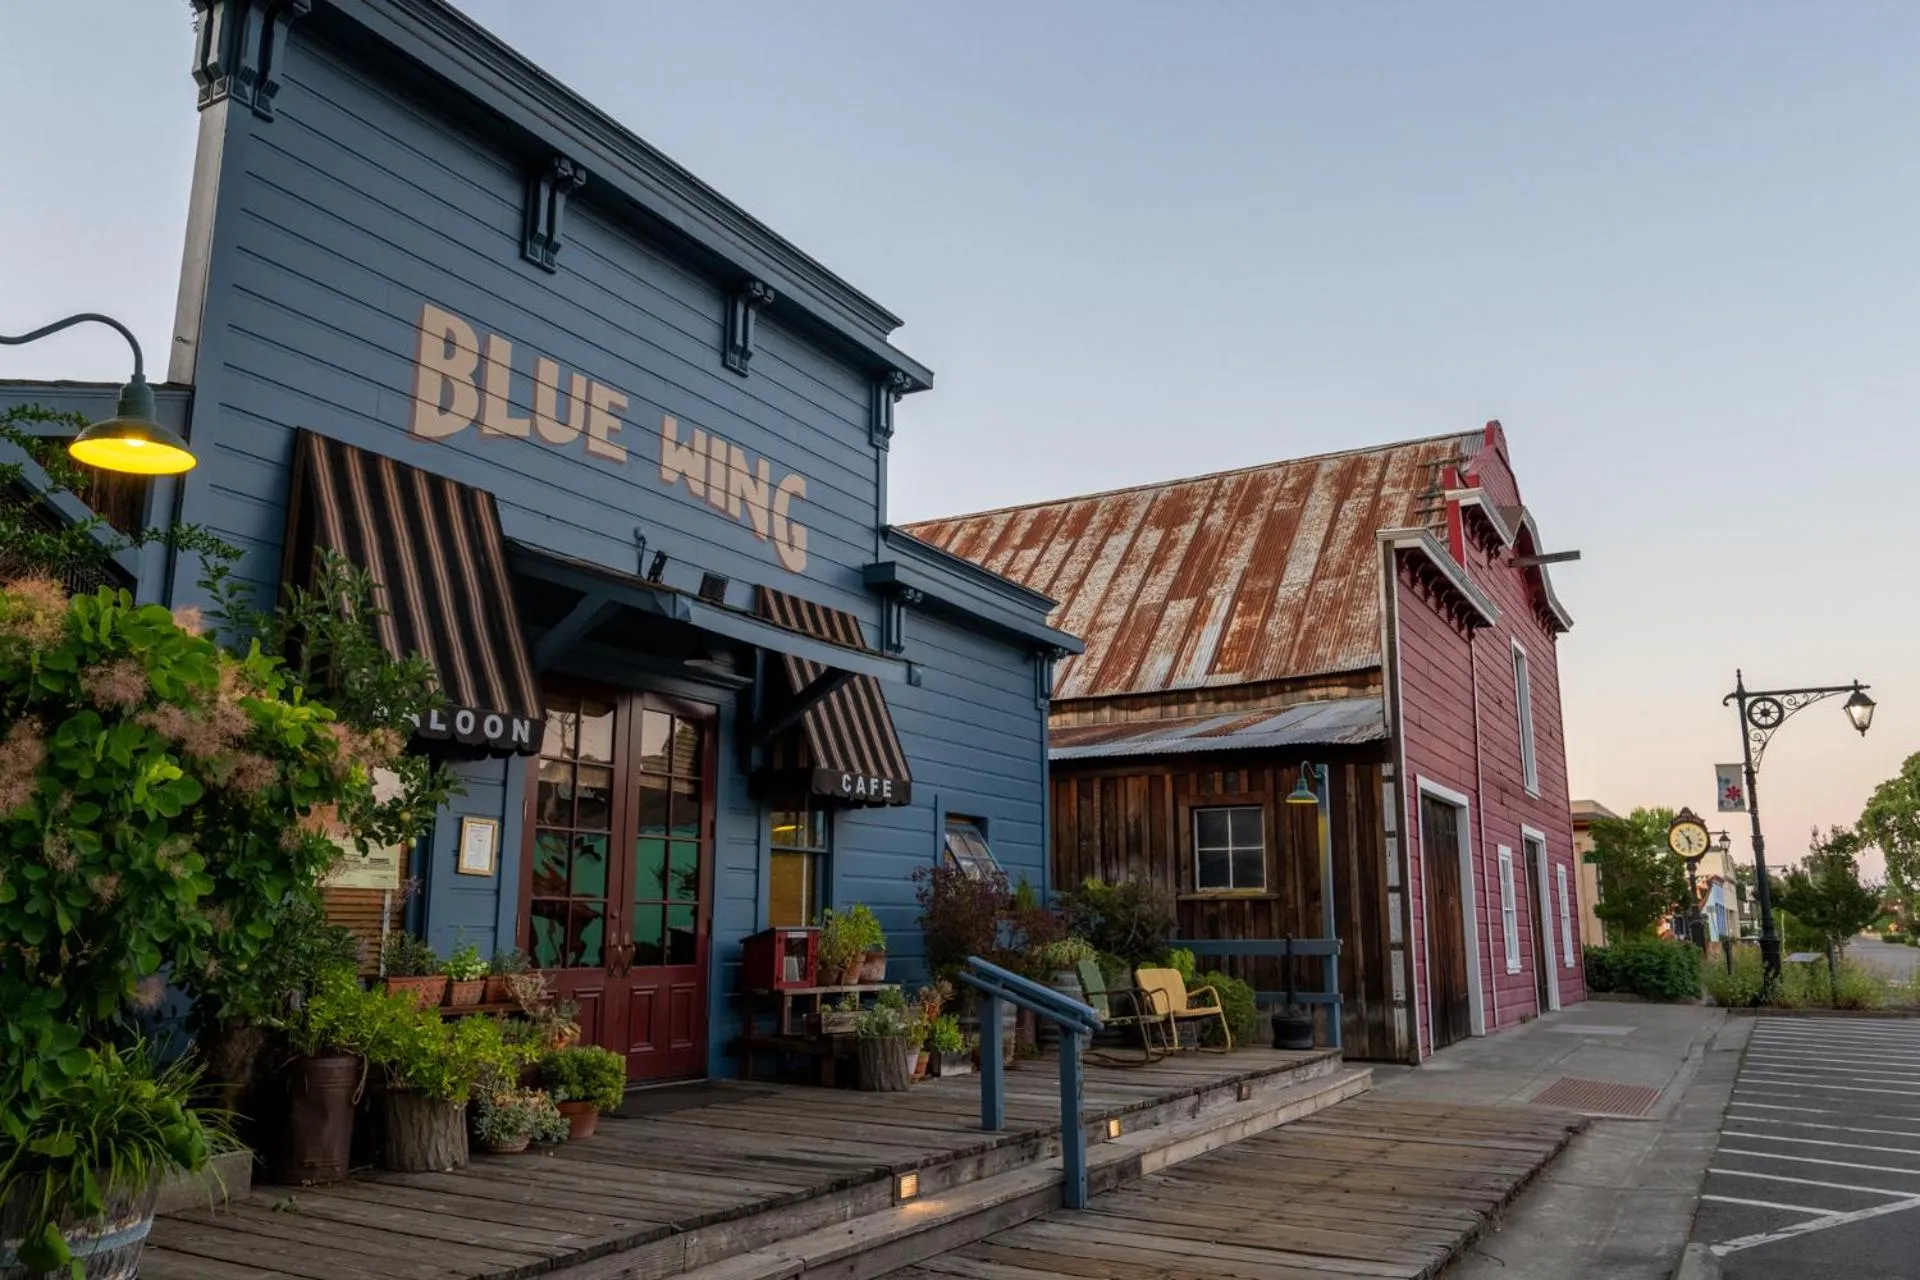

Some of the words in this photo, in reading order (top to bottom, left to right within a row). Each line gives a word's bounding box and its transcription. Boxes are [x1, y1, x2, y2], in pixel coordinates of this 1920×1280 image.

[410, 303, 628, 463] BLUE
[660, 414, 808, 574] WING
[373, 700, 530, 744] LOON
[842, 774, 892, 798] CAFE
